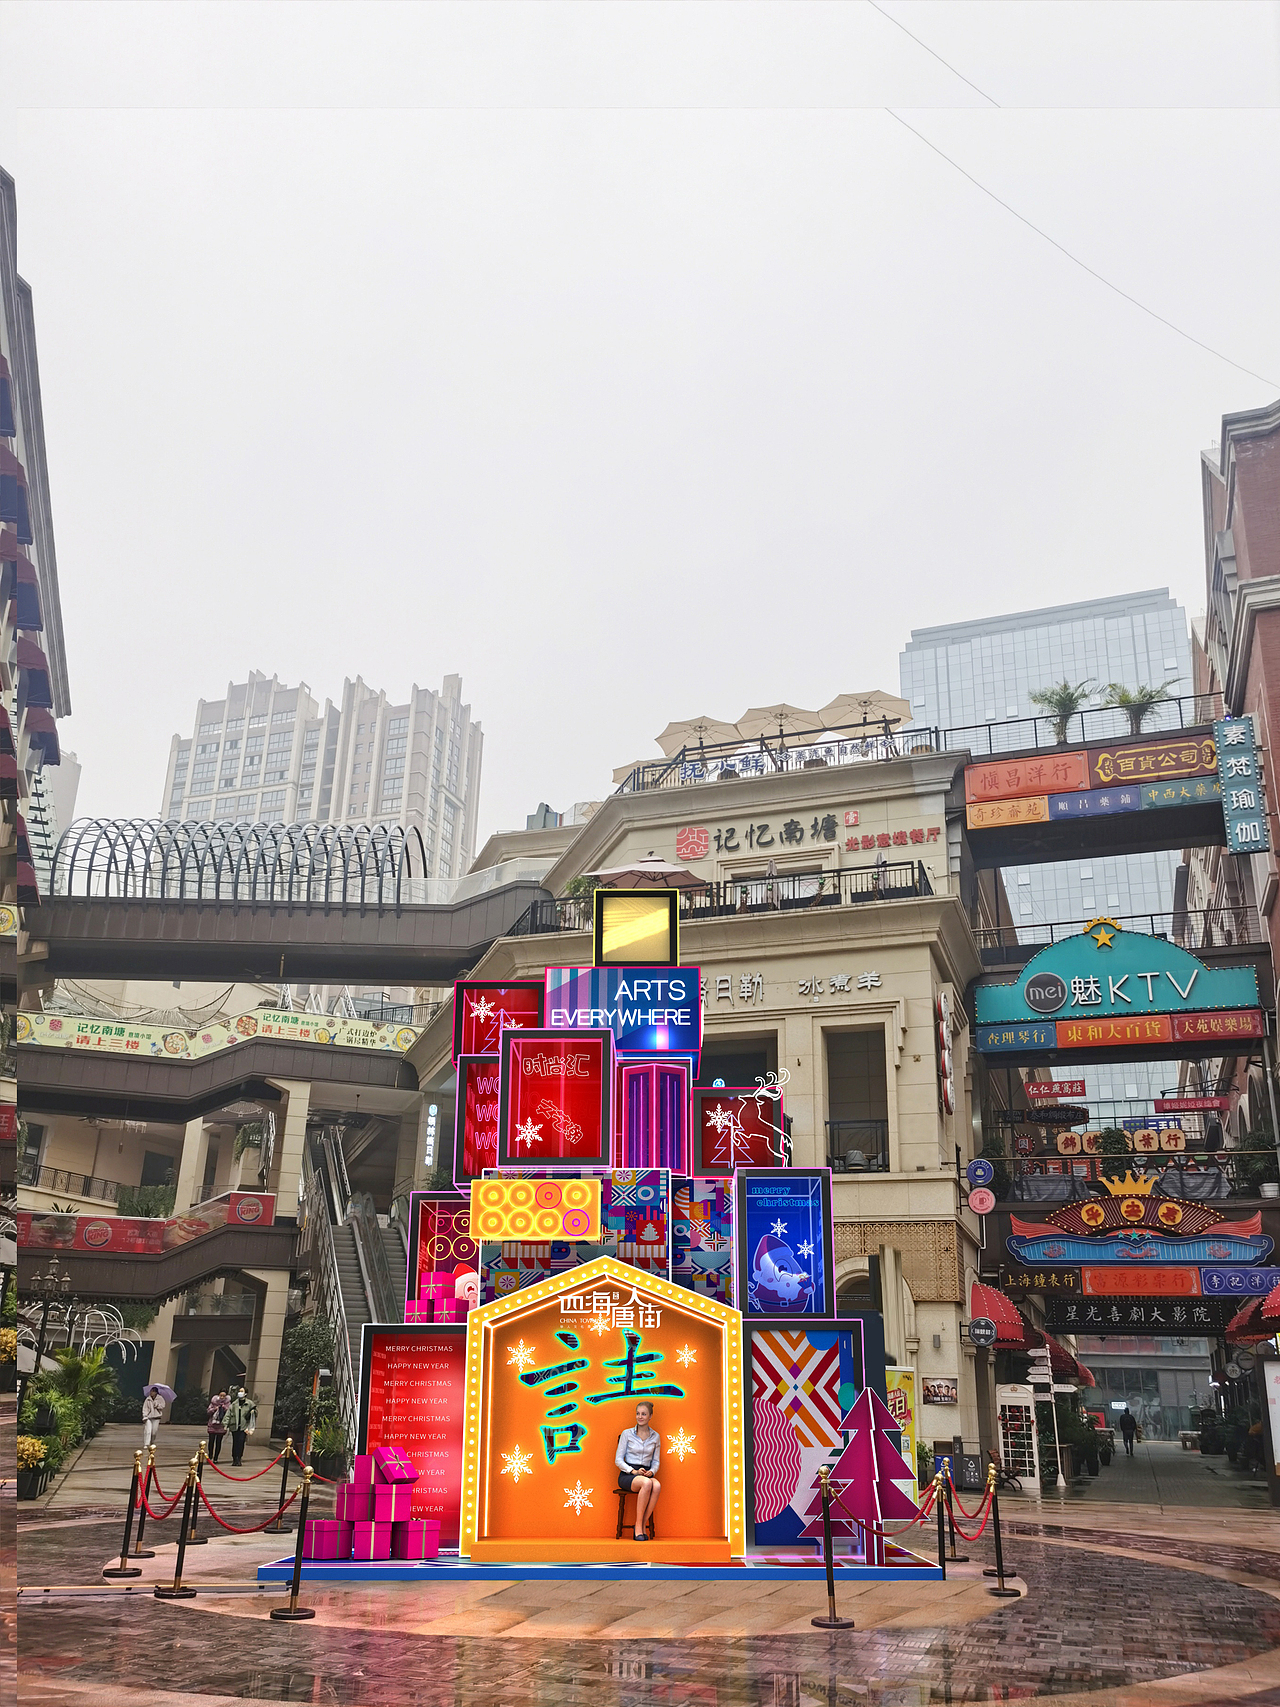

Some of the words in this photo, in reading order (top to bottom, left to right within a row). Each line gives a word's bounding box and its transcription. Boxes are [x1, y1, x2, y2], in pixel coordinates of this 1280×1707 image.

[1116, 749, 1198, 773] 百貨公司
[1223, 725, 1260, 843] 素梵瑜伽
[713, 813, 839, 852] 记忆南塘
[844, 826, 941, 851] 光影意境餐厅
[614, 979, 686, 1001] ARTS
[1029, 982, 1062, 1001] mei
[262, 1013, 300, 1025] 记忆南塘
[551, 1008, 691, 1027] EVERYWHERE
[77, 1022, 125, 1037] 记忆南塘
[261, 1024, 310, 1038] 请上三楼
[76, 1034, 140, 1050] 请上三楼
[522, 1053, 590, 1077] 时尚汇
[751, 1186, 791, 1196] merry
[756, 1198, 819, 1207] christmas
[87, 1230, 109, 1241] KING
[1065, 1305, 1211, 1324] 星光喜劇大影院
